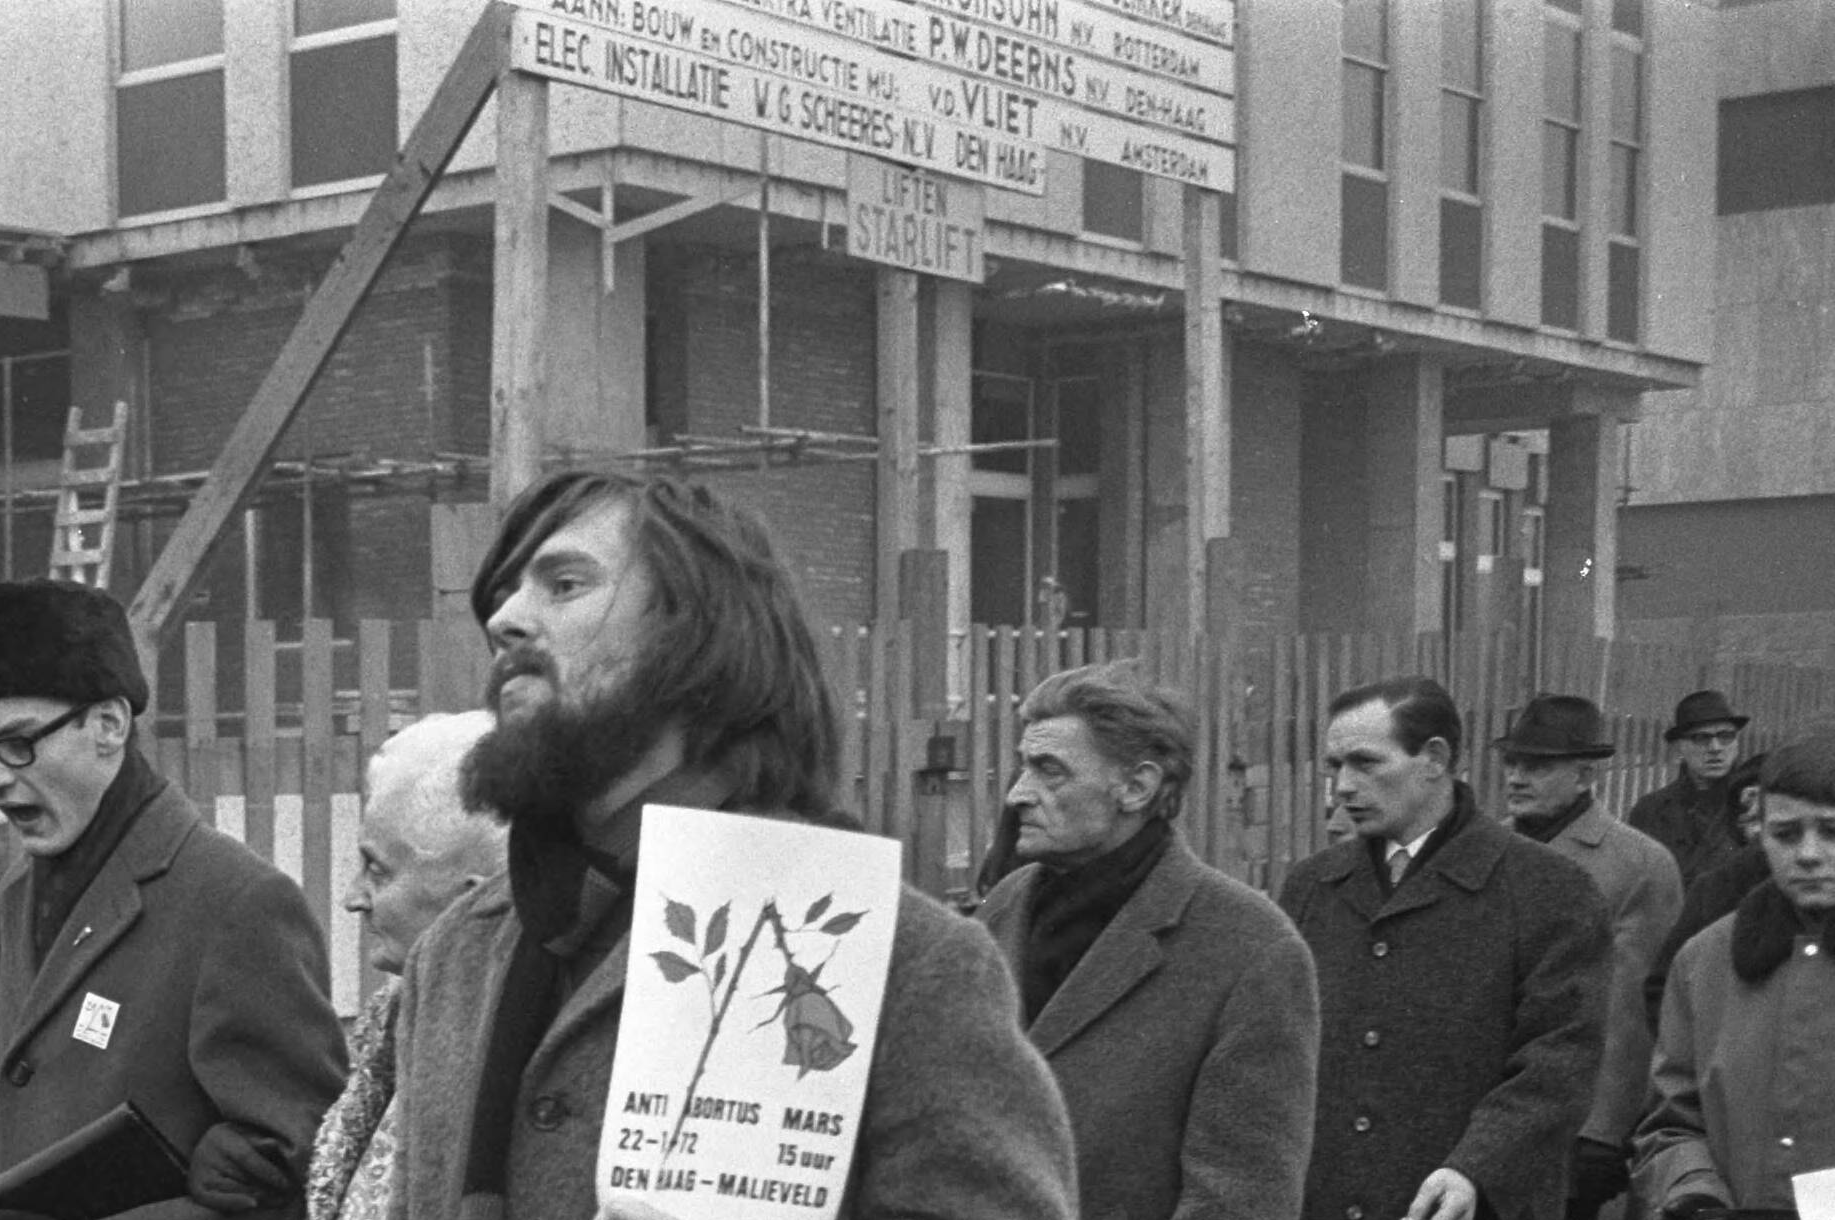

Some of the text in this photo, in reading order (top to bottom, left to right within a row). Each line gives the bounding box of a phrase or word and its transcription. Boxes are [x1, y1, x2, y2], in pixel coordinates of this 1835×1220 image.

[822, 0, 916, 50] VENTILATIE
[1114, 31, 1200, 76] ROTTERDAM
[605, 40, 730, 109] INSTALLATIE
[956, 130, 989, 174] DEN
[633, 1, 694, 42] BOUW
[728, 28, 858, 92] CONSTRUCTIE
[1121, 140, 1208, 179] AMSTERDAM
[882, 168, 947, 217] LIFTEN
[856, 202, 976, 274] STARLIFT
[623, 1091, 668, 1117] ANTI
[782, 1107, 844, 1136] MARS
[777, 1143, 798, 1167] 15
[800, 1151, 835, 1170] uur
[610, 1166, 650, 1191] DEN
[654, 1168, 696, 1192] HAAG
[717, 1173, 828, 1208] MALIEVELD
